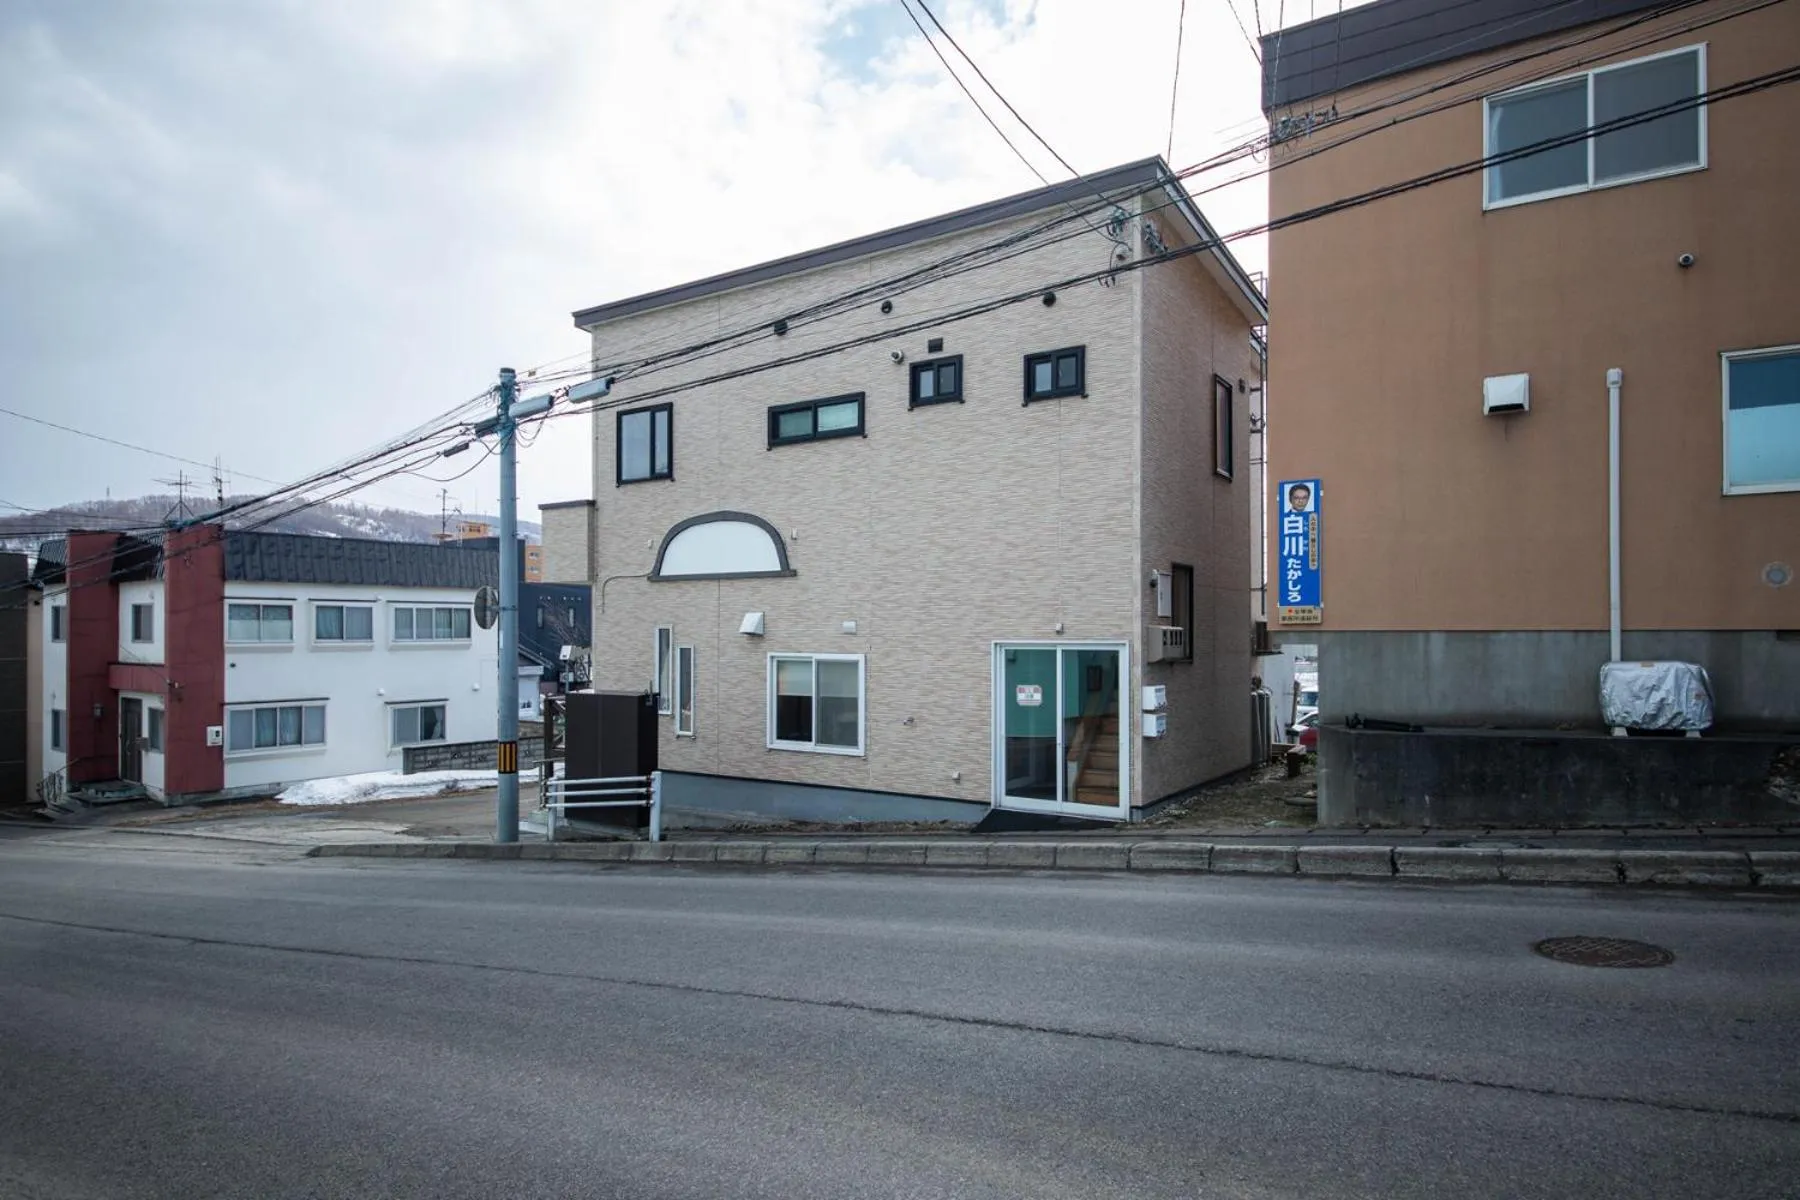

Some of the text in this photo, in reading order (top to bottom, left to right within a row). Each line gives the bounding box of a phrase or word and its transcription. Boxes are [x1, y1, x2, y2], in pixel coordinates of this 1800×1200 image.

[1283, 514, 1303, 602] 白川たかしろ
